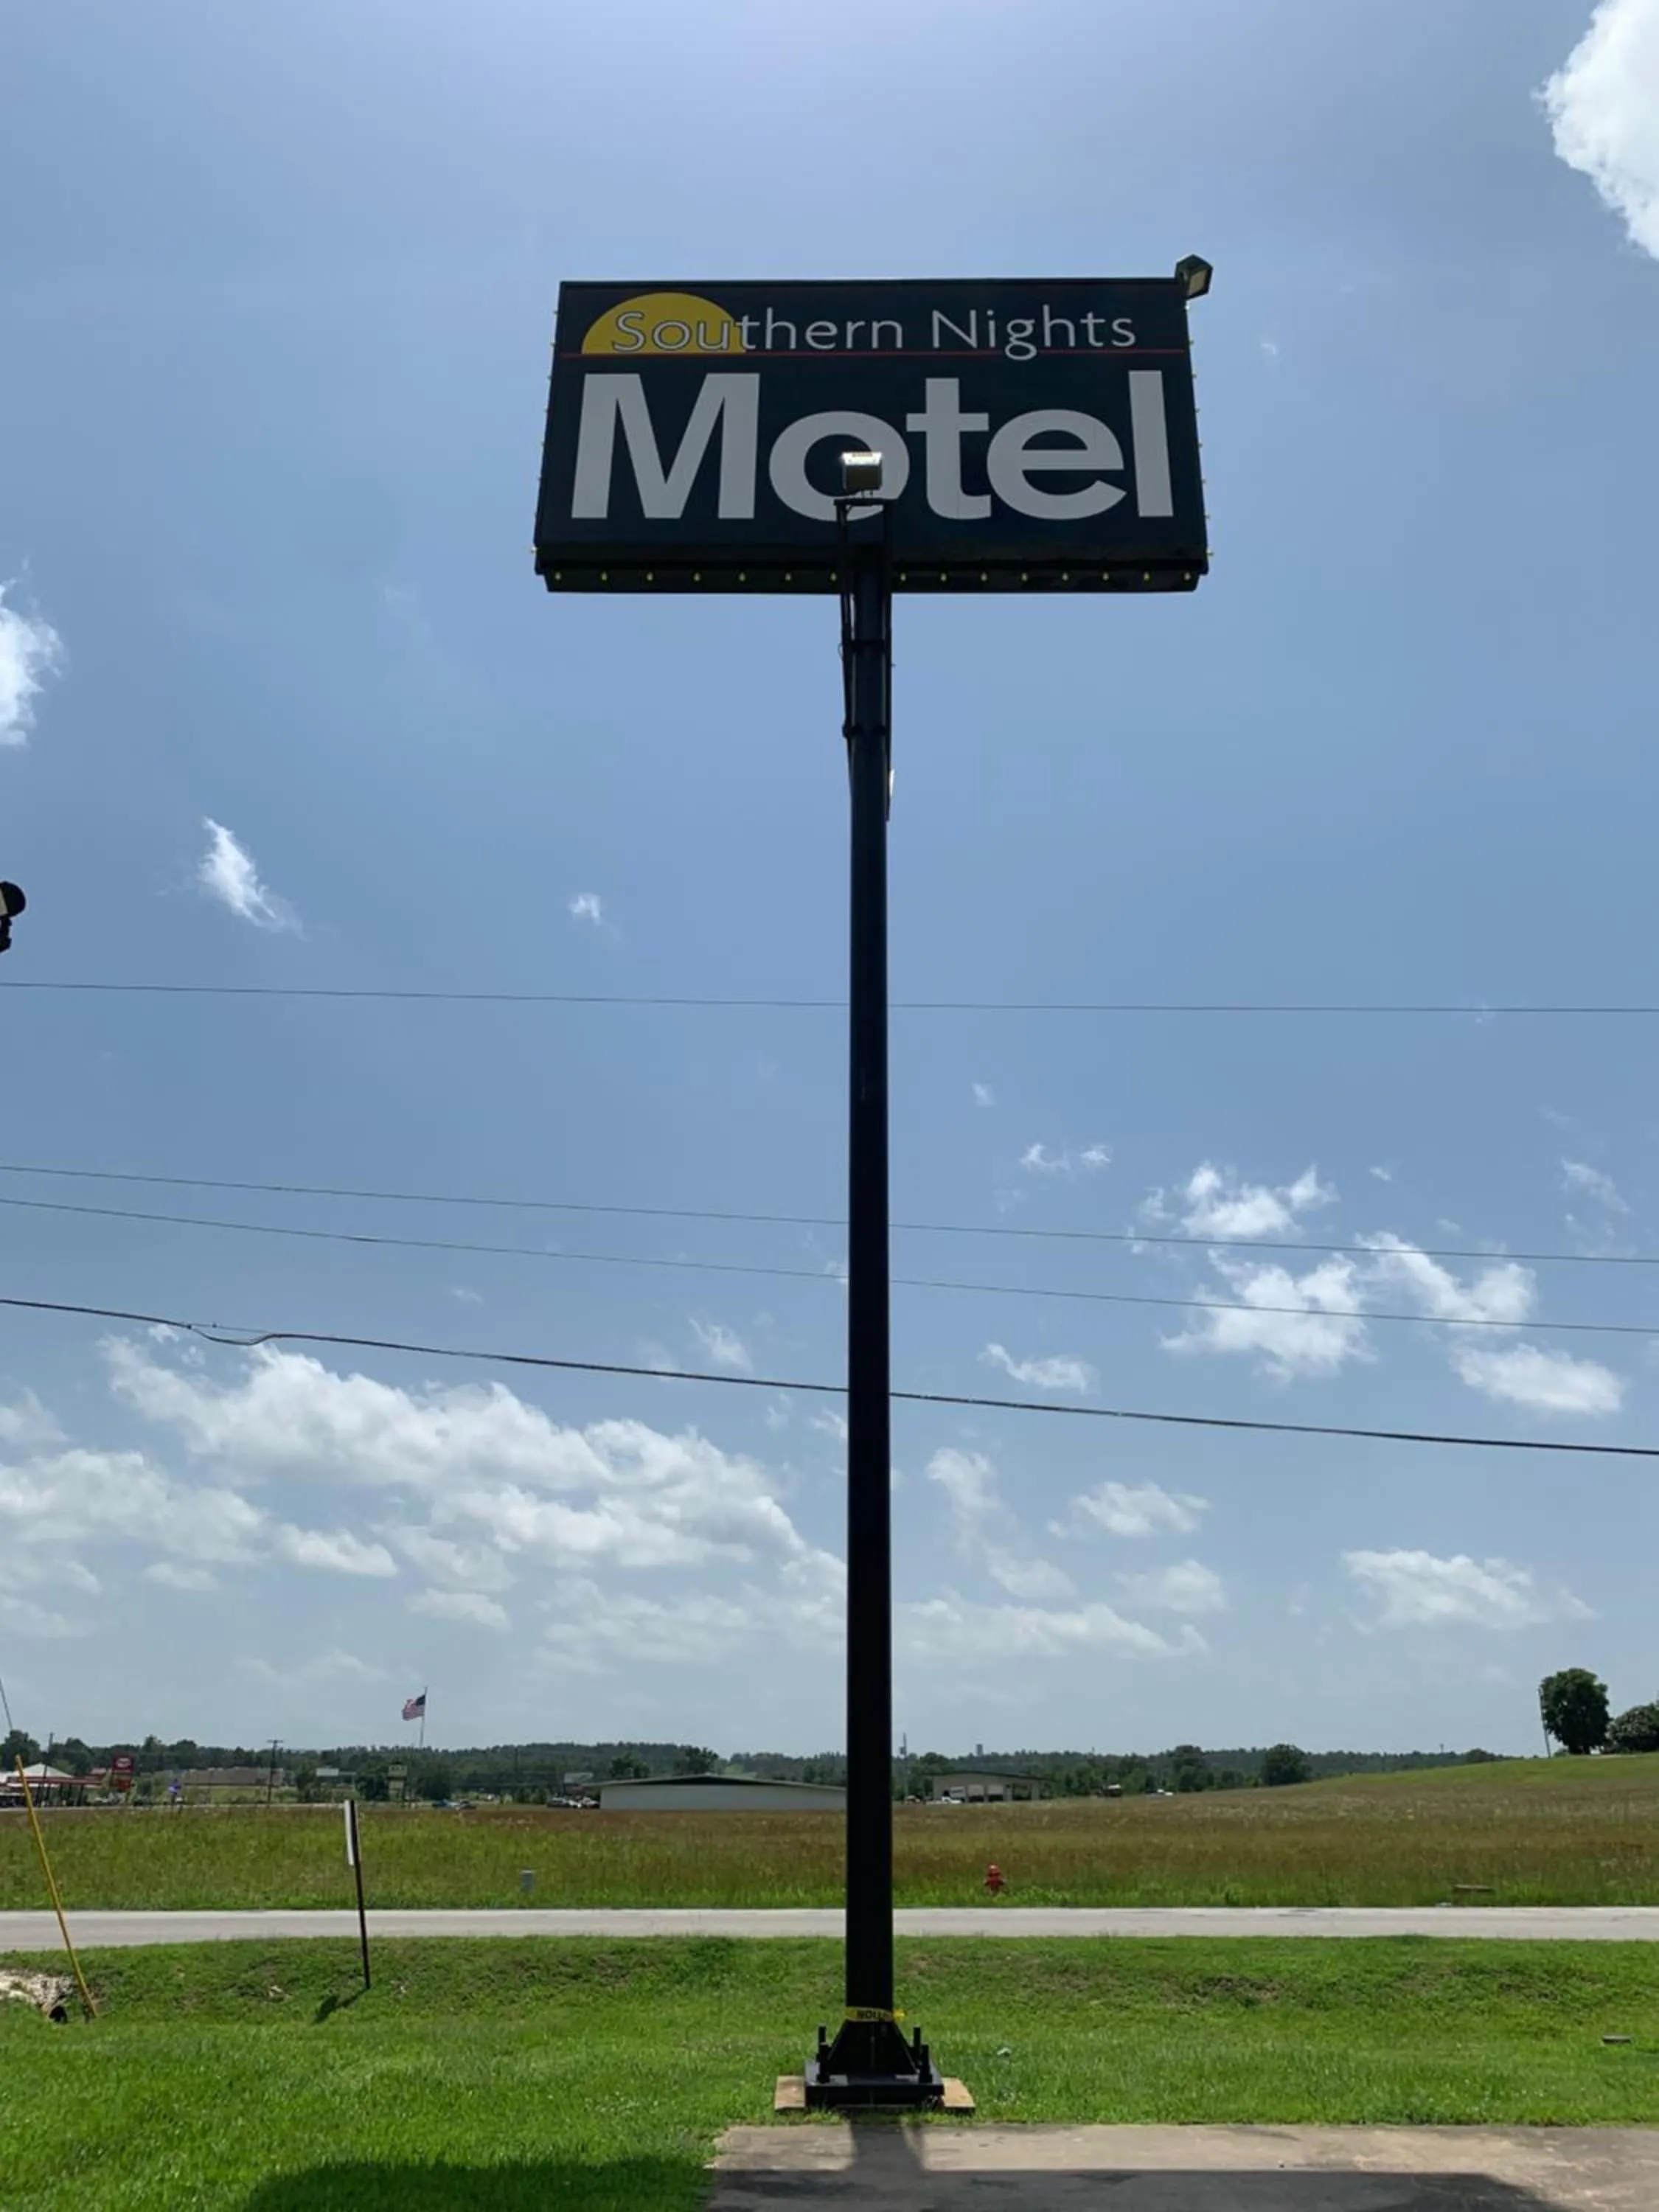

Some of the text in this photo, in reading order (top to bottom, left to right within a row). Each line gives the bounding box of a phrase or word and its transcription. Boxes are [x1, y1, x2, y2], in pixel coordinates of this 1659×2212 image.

[613, 304, 1136, 360] Southern Nights
[571, 370, 1174, 522] Motel
